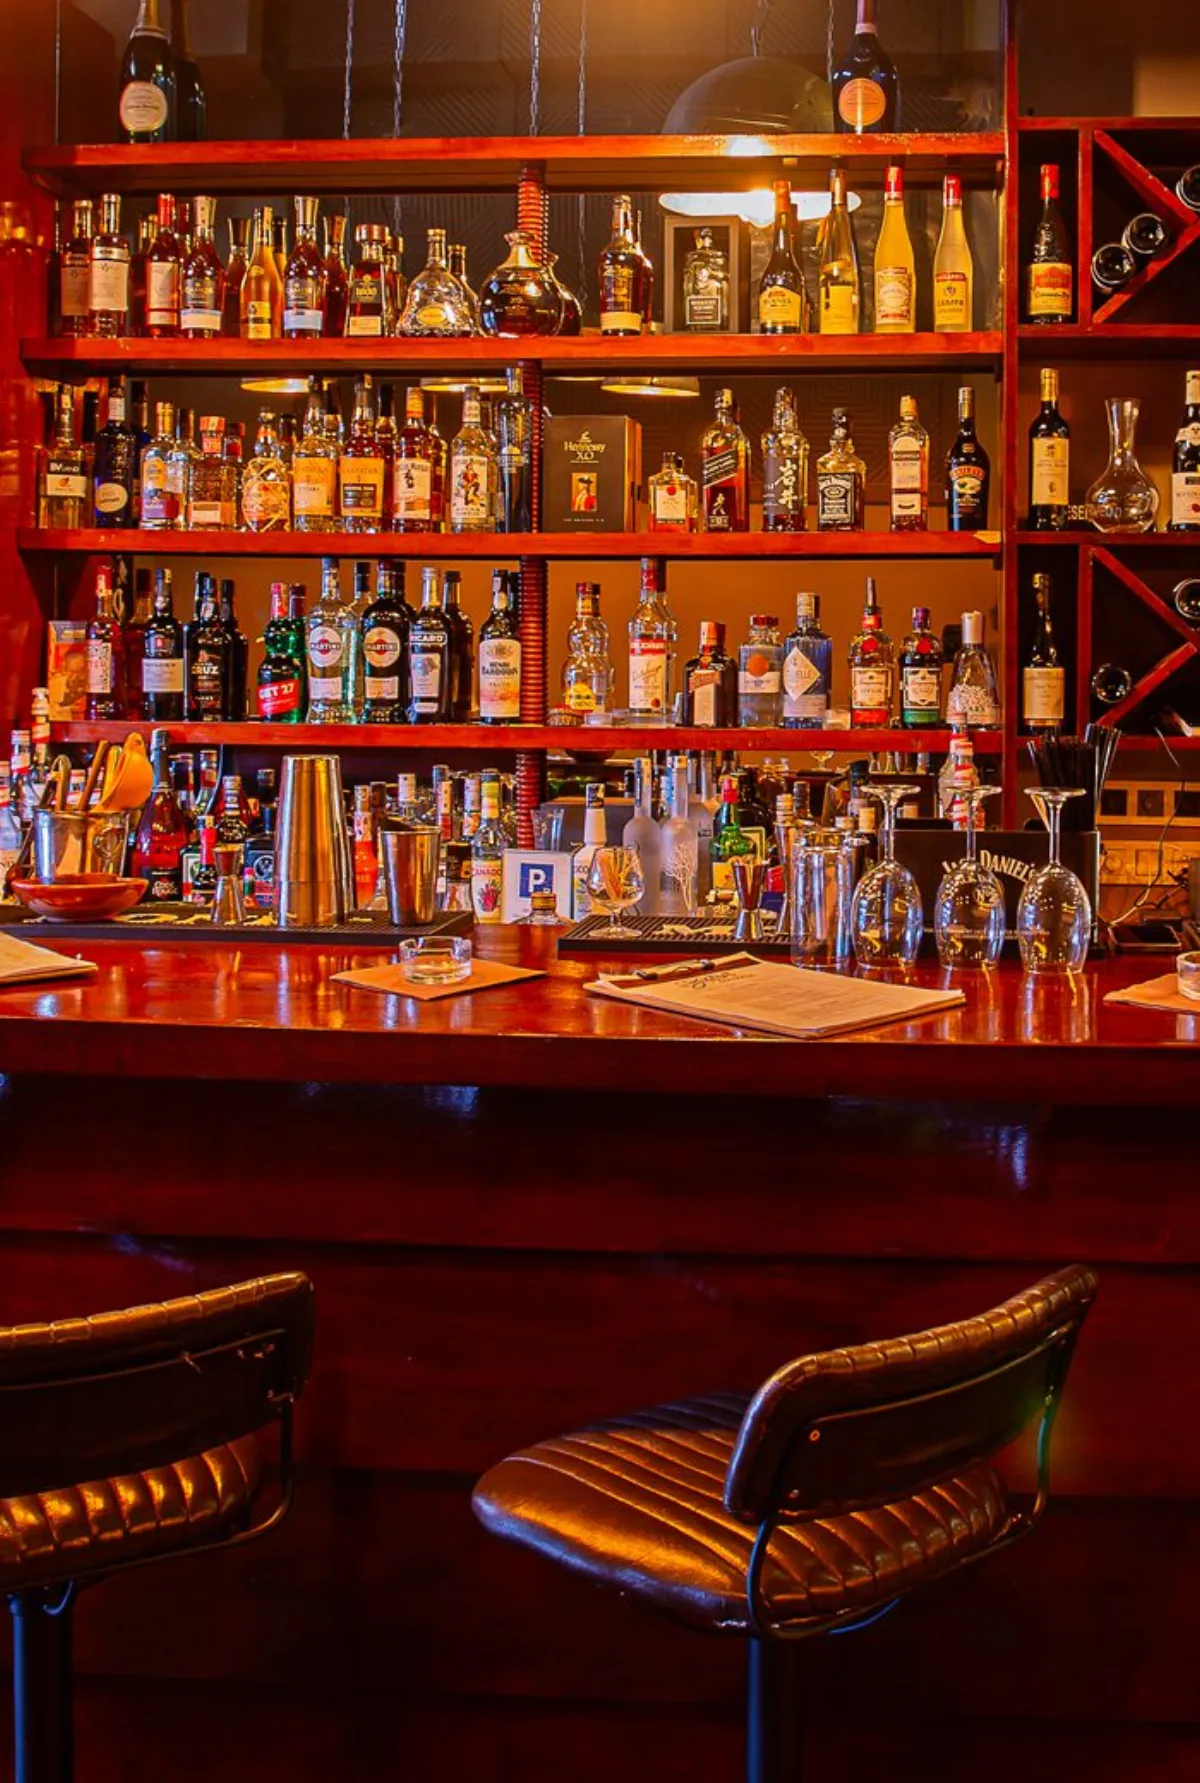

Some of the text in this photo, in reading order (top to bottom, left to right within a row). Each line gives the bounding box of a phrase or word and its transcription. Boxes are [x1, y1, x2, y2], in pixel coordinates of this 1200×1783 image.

[563, 441, 606, 453] Hennessy
[310, 643, 341, 651] MARTINI
[365, 643, 398, 651] MARTINI
[191, 666, 220, 675] CRUZ
[258, 683, 295, 700] GET 27
[472, 868, 504, 877] CANADO
[529, 868, 546, 893] P
